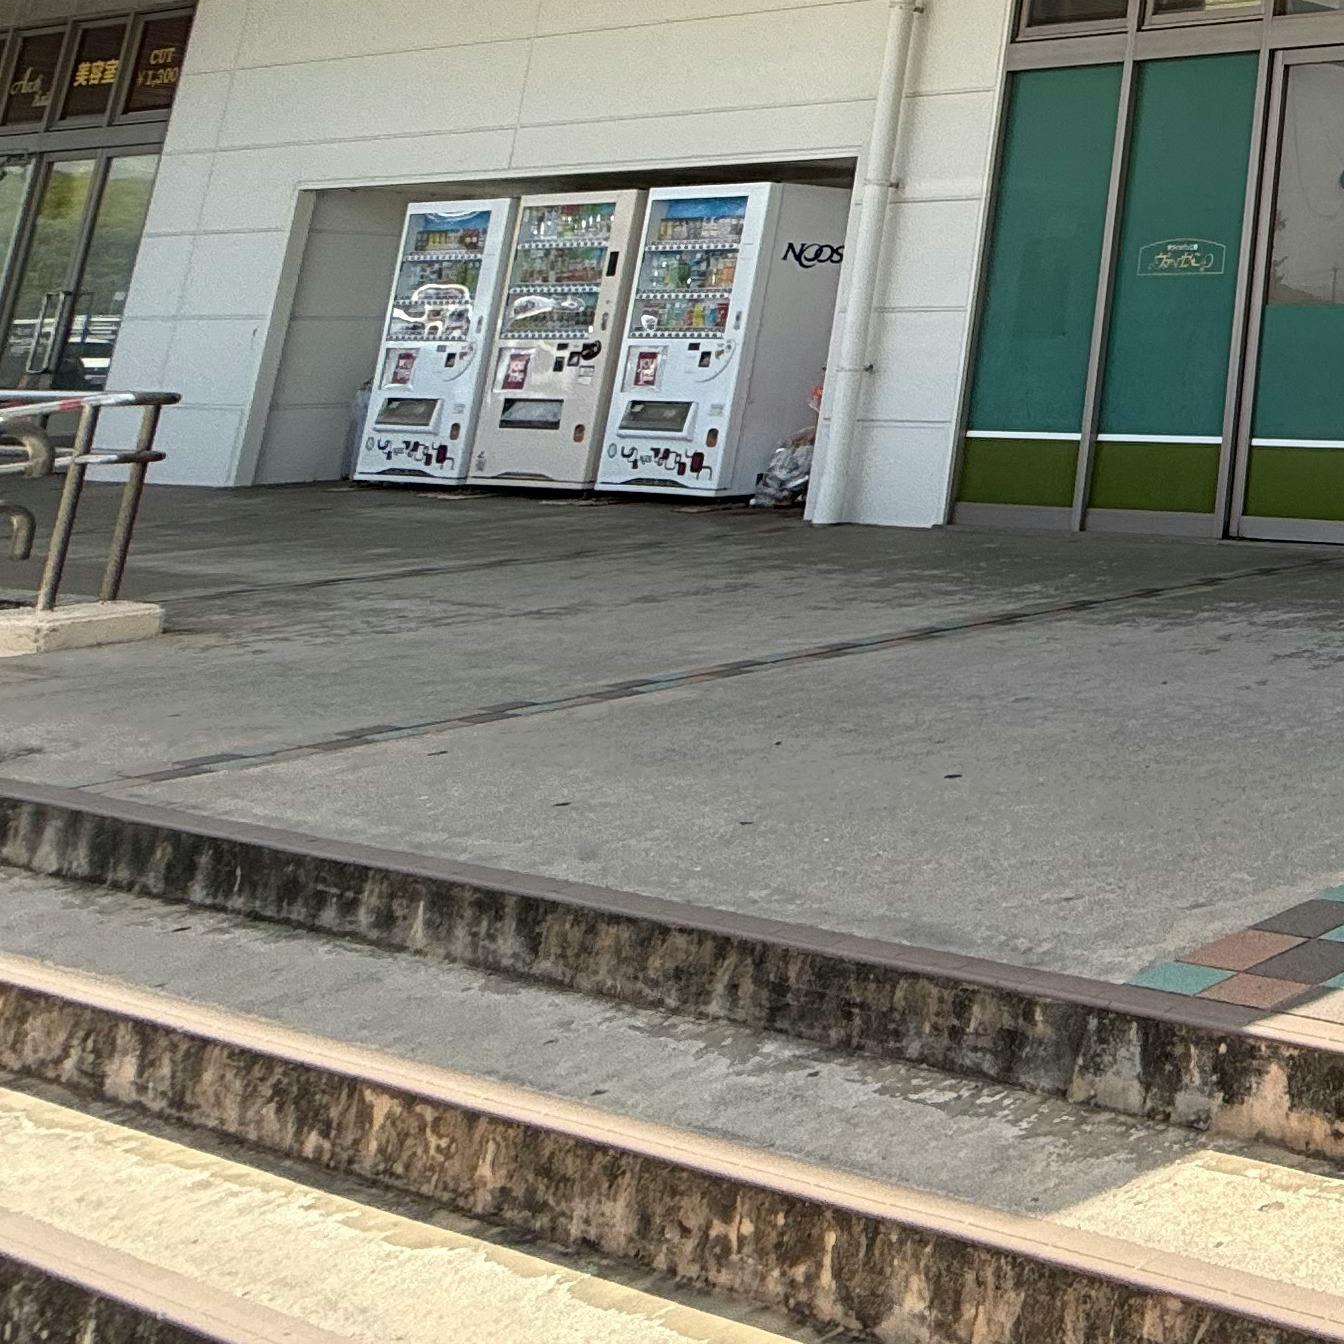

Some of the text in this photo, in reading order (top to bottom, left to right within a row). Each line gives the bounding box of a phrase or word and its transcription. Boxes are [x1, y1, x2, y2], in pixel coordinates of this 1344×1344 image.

[151, 47, 176, 64] CUT
[73, 58, 120, 87] 美容室
